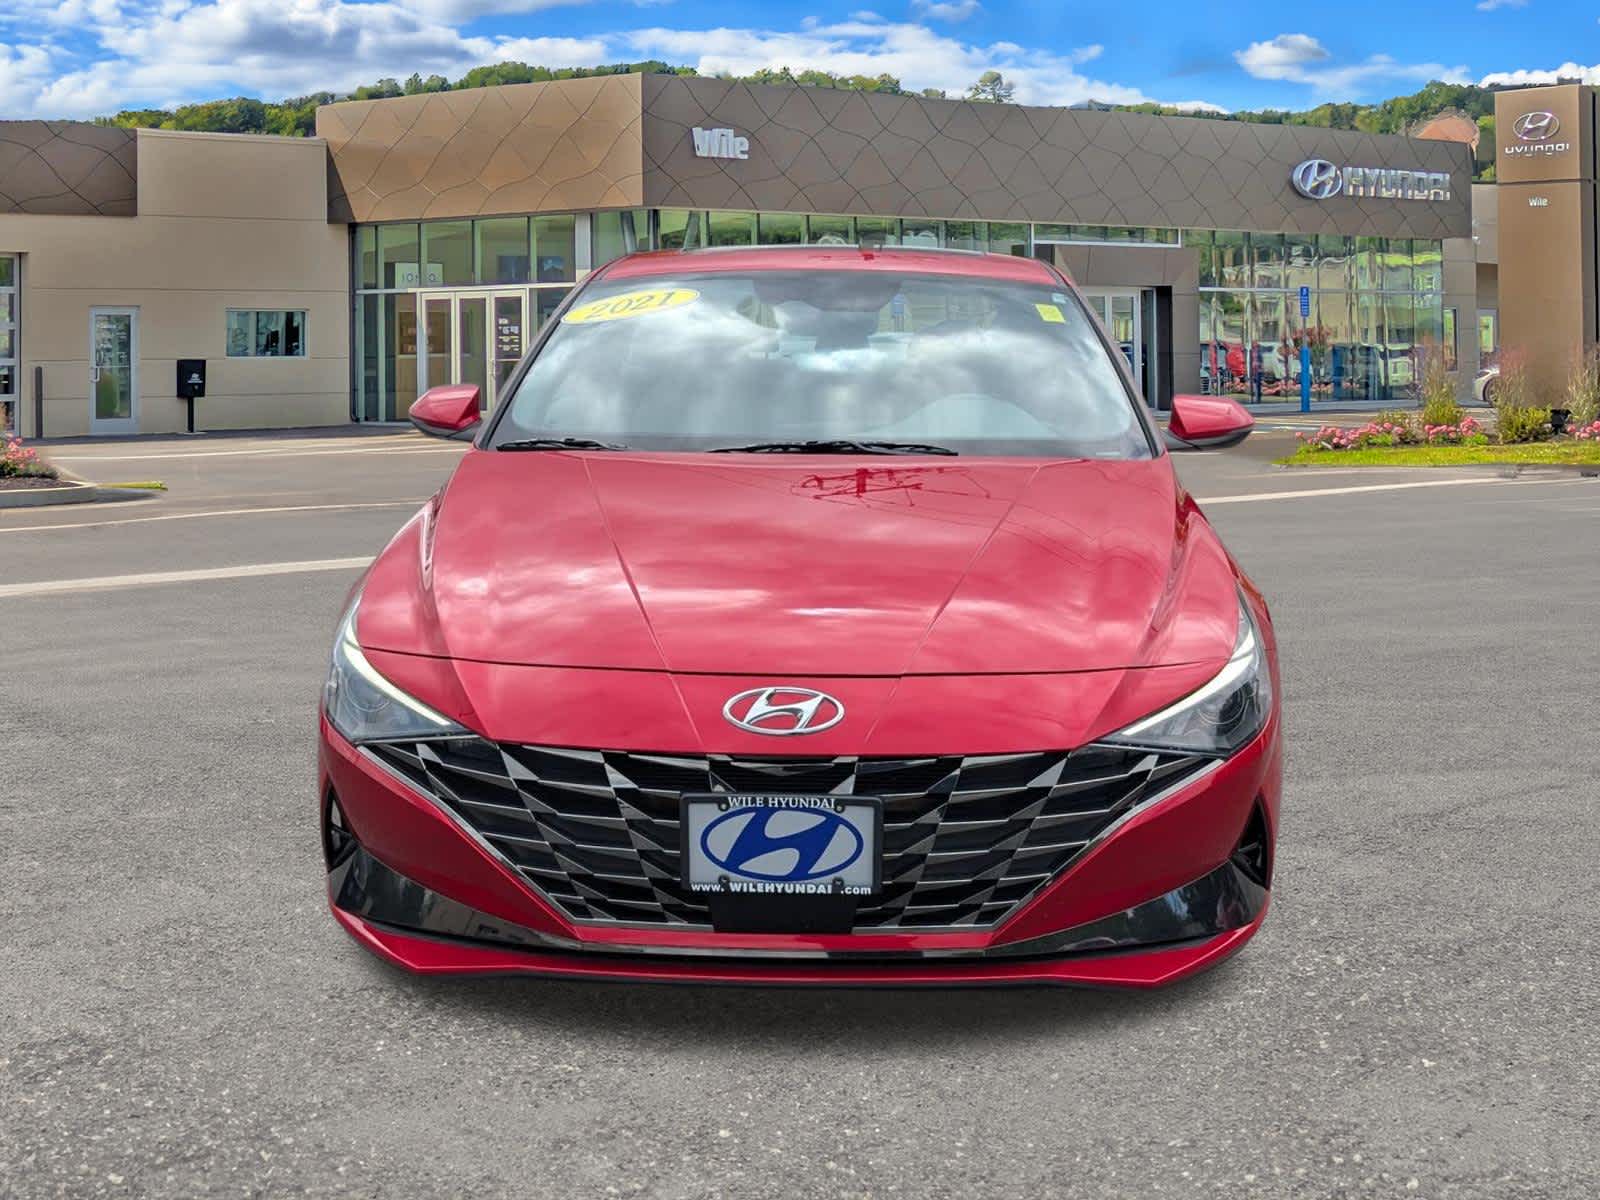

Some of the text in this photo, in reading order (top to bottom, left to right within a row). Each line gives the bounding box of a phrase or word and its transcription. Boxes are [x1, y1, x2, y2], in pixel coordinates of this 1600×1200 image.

[692, 127, 749, 160] Wile
[1343, 166, 1451, 201] HYUNDAI
[585, 291, 676, 319] 2021
[727, 796, 836, 810] WILE HYUNDAI
[691, 883, 725, 893] www.
[729, 881, 833, 895] WILEHYUNDAI
